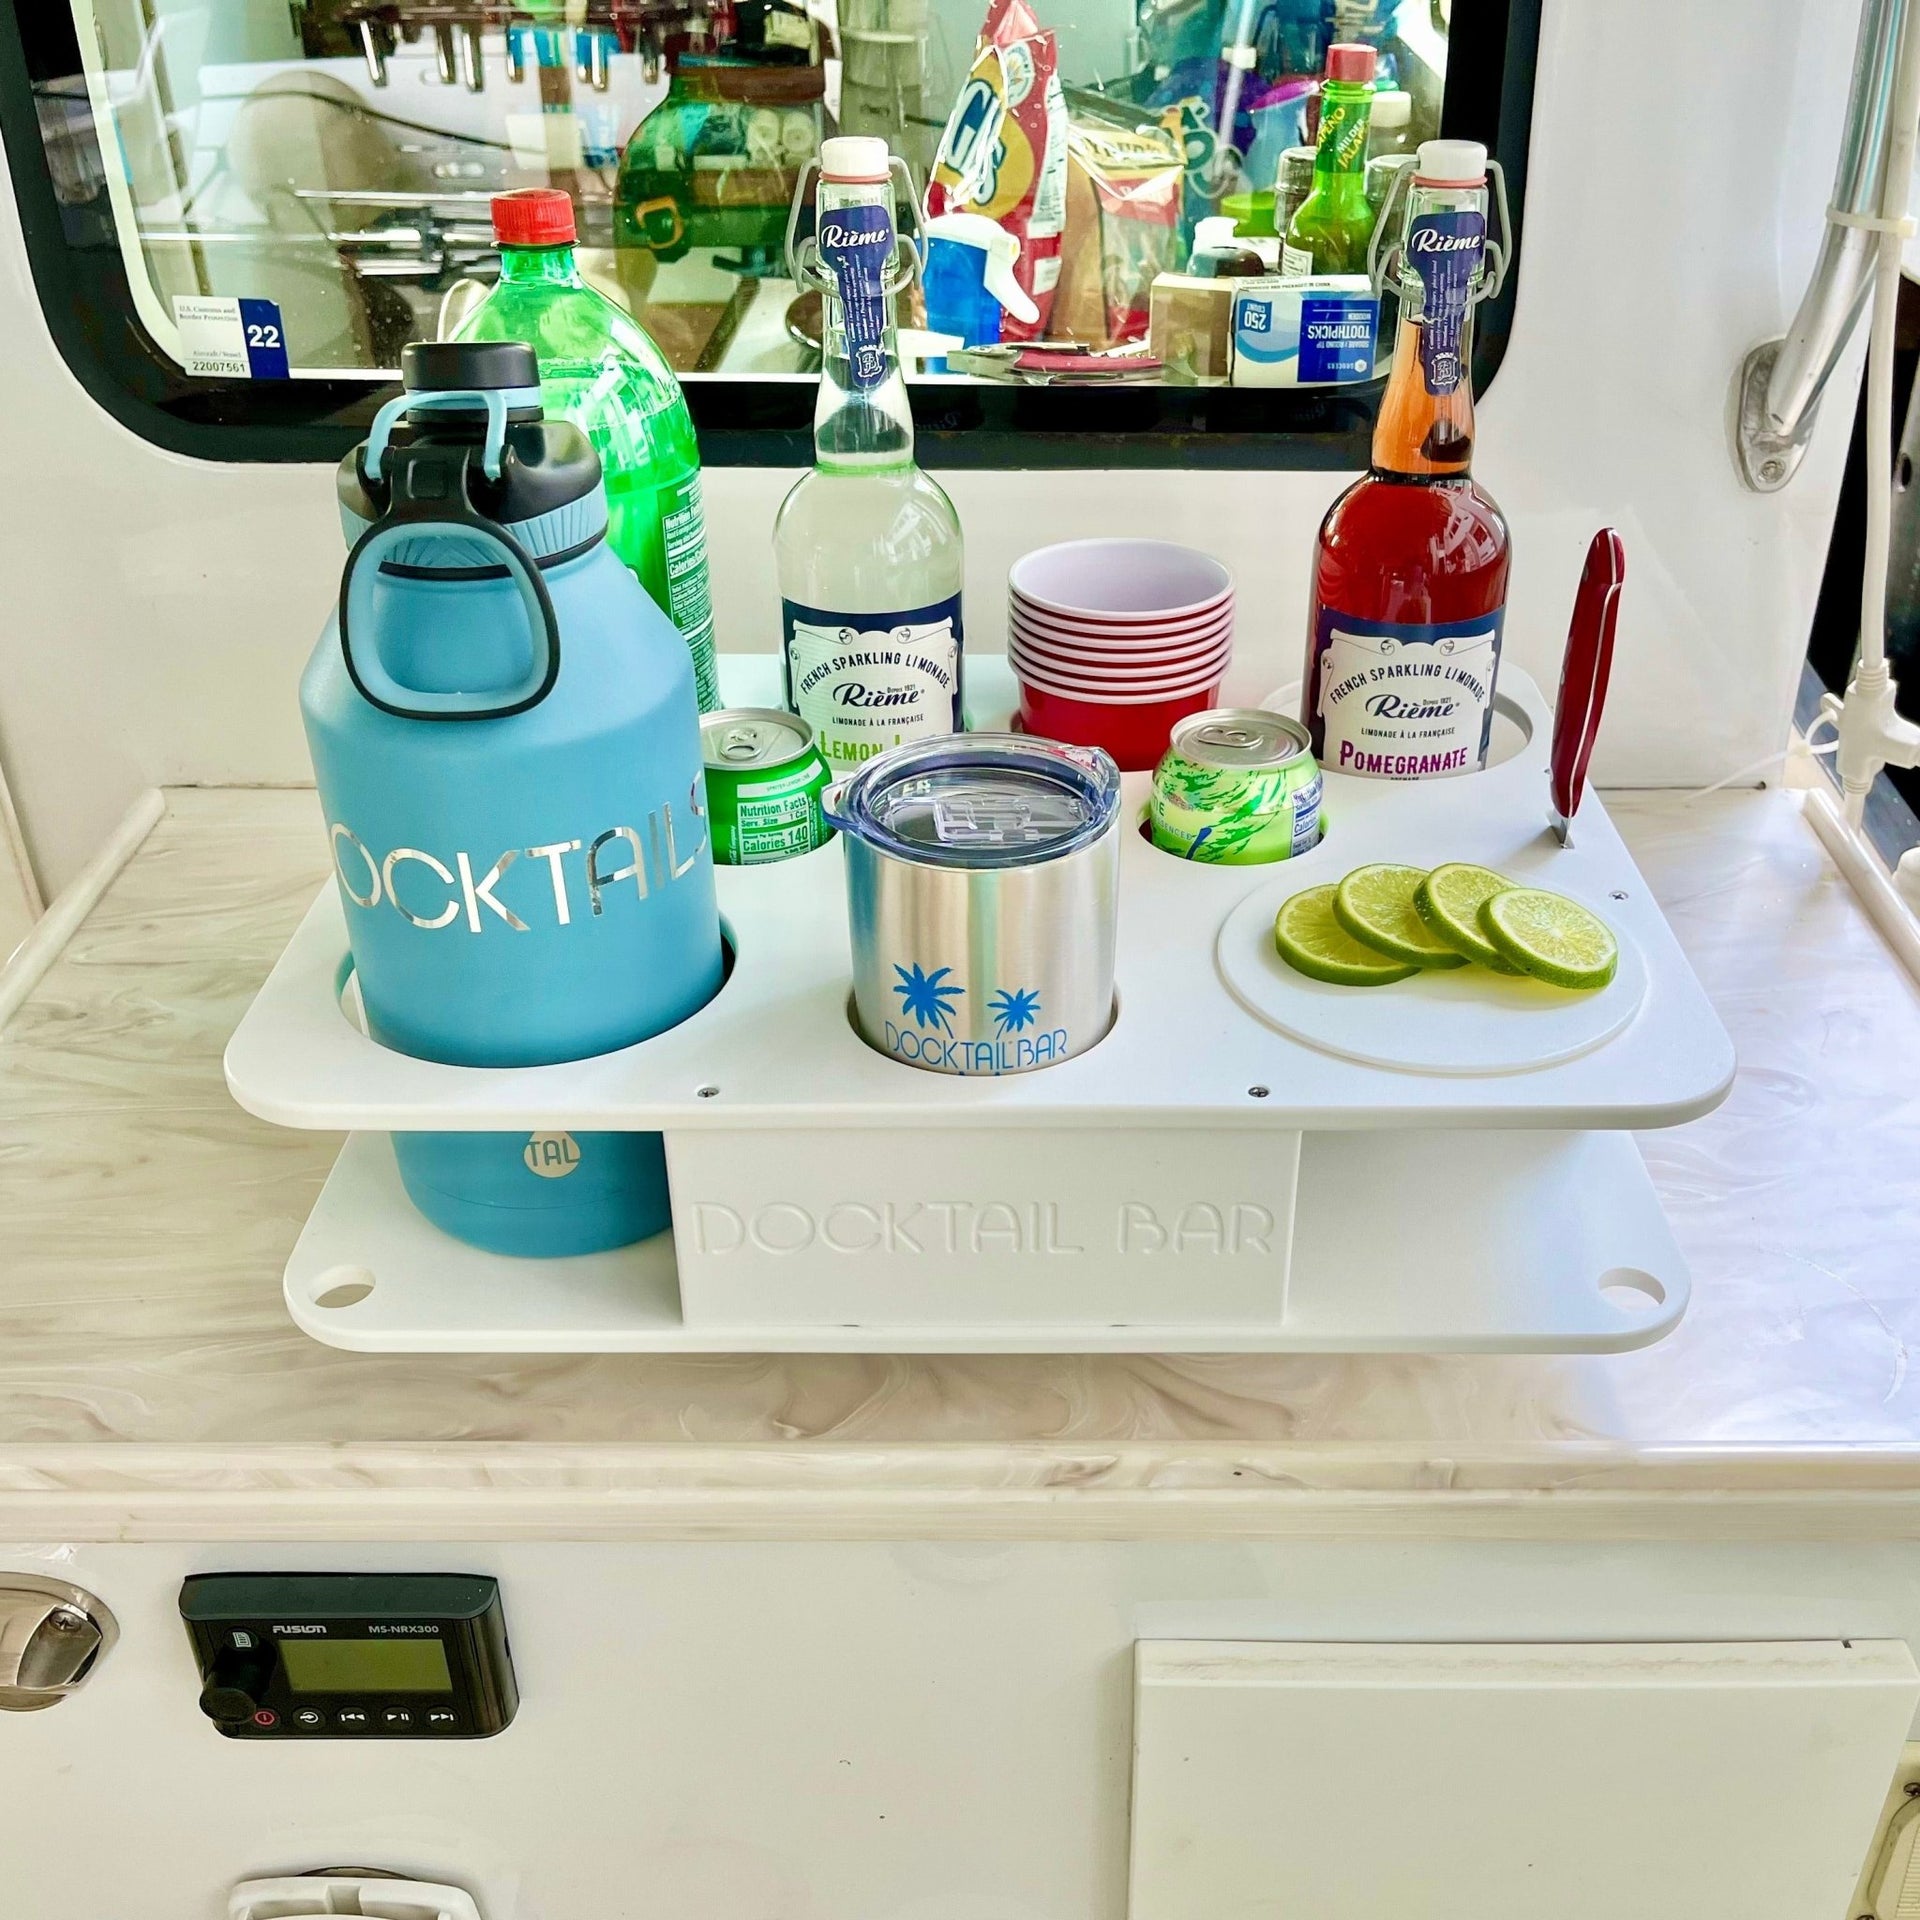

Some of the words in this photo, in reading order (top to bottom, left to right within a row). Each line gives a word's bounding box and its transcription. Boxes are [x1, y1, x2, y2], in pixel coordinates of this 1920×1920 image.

[821, 224, 886, 248] Rième
[1411, 228, 1480, 252] Rième
[1244, 310, 1267, 331] 250
[1307, 324, 1371, 340] TOOTHPICKS
[247, 324, 281, 348] 22
[192, 361, 245, 373] 22007561
[799, 662, 832, 695] FRENCH
[832, 652, 902, 672] SPARKLING
[905, 653, 951, 689] LIMONADE
[1329, 672, 1367, 705] FRENCH
[1370, 663, 1442, 682] SPARKLING
[1445, 666, 1486, 703] LIMONADE
[832, 682, 921, 708] Rième
[1365, 693, 1456, 719] Rième
[832, 716, 866, 727] LIMONADE
[876, 718, 886, 727] LA
[888, 713, 924, 727] FRANÇAISE
[1360, 727, 1397, 739] LIMONADE
[1407, 728, 1417, 739] LA
[1419, 727, 1456, 740] FRANÇAISE
[1339, 739, 1468, 775] POMEGRANATE
[740, 802, 781, 818] Nutrition
[783, 797, 807, 812] Facts
[742, 838, 786, 852] Calories
[788, 825, 808, 845] 140
[690, 1200, 1085, 1255] DOCKTAIL
[1117, 1200, 1276, 1255] BAR
[272, 1624, 327, 1634] FUSION
[367, 1624, 440, 1634] MS-NRX300
